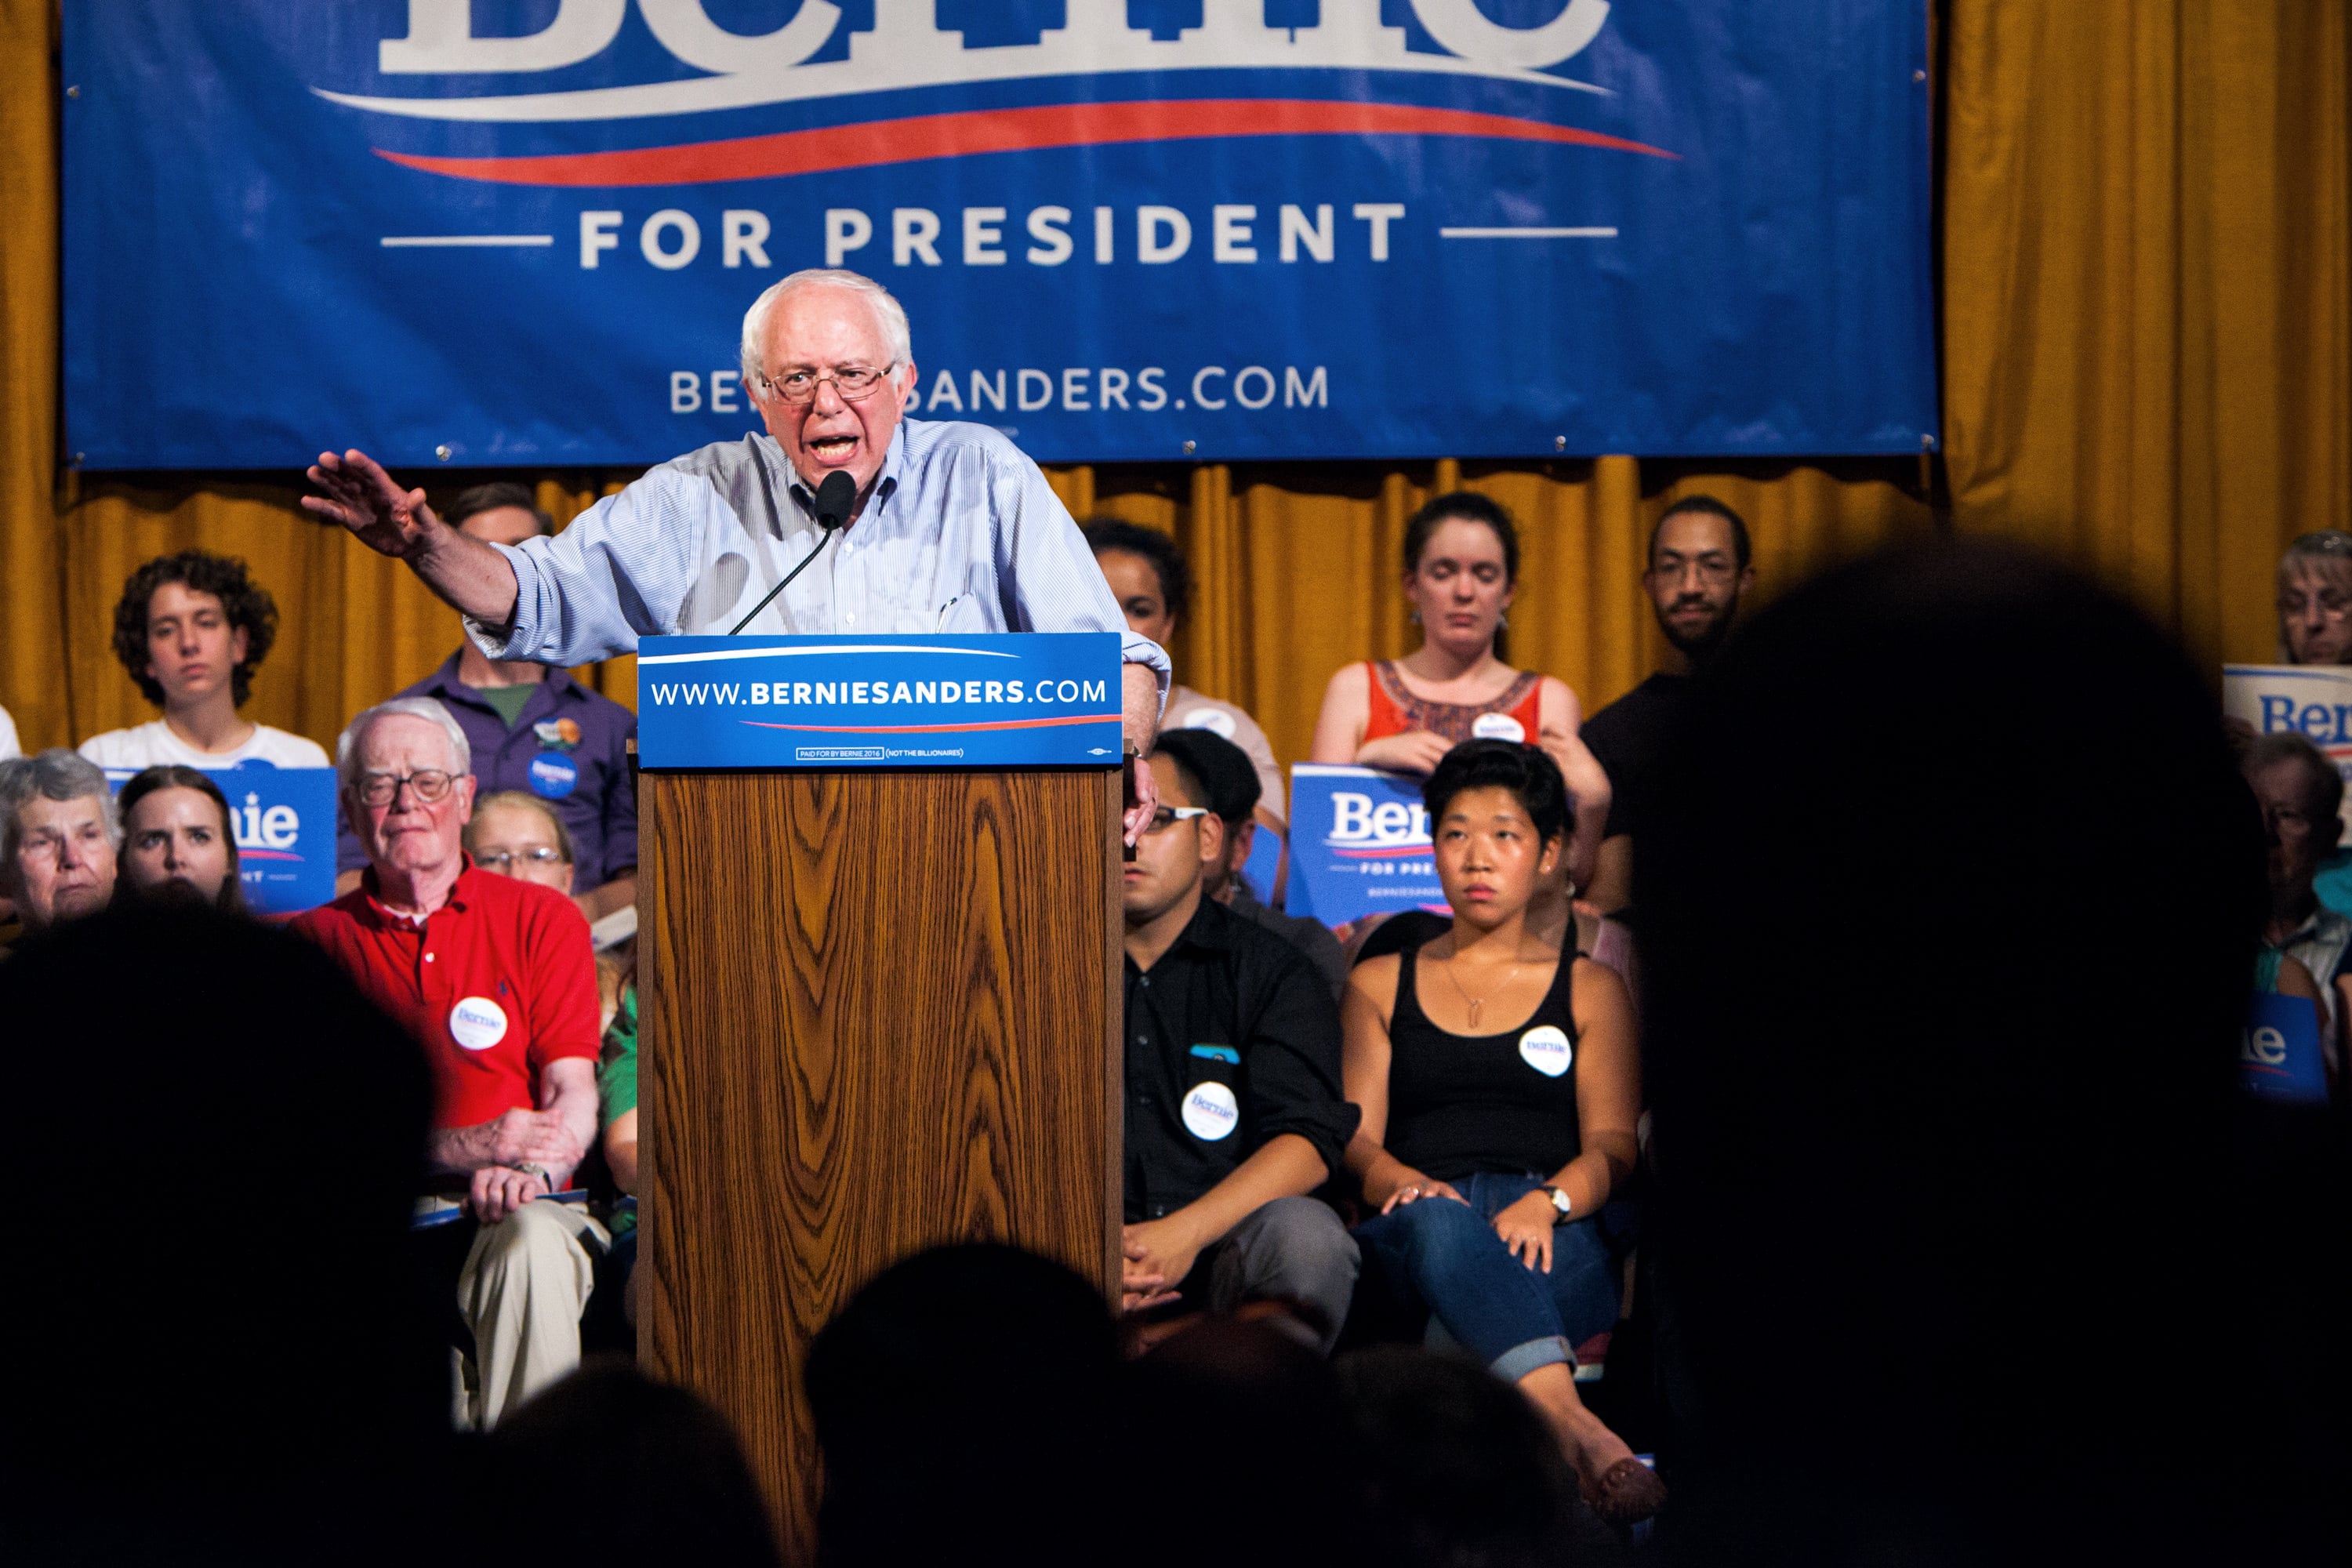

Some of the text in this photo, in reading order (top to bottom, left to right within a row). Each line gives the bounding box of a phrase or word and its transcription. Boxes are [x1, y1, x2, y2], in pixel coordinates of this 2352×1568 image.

[581, 204, 1404, 269] FOR PRESIDENT
[652, 681, 1105, 705] WWW.BERNIESANDERS.COM
[2260, 696, 2352, 743] Ber
[886, 748, 902, 759] (NOT
[917, 748, 964, 759] BILLIONAIRES)
[1330, 792, 1432, 842] Ber
